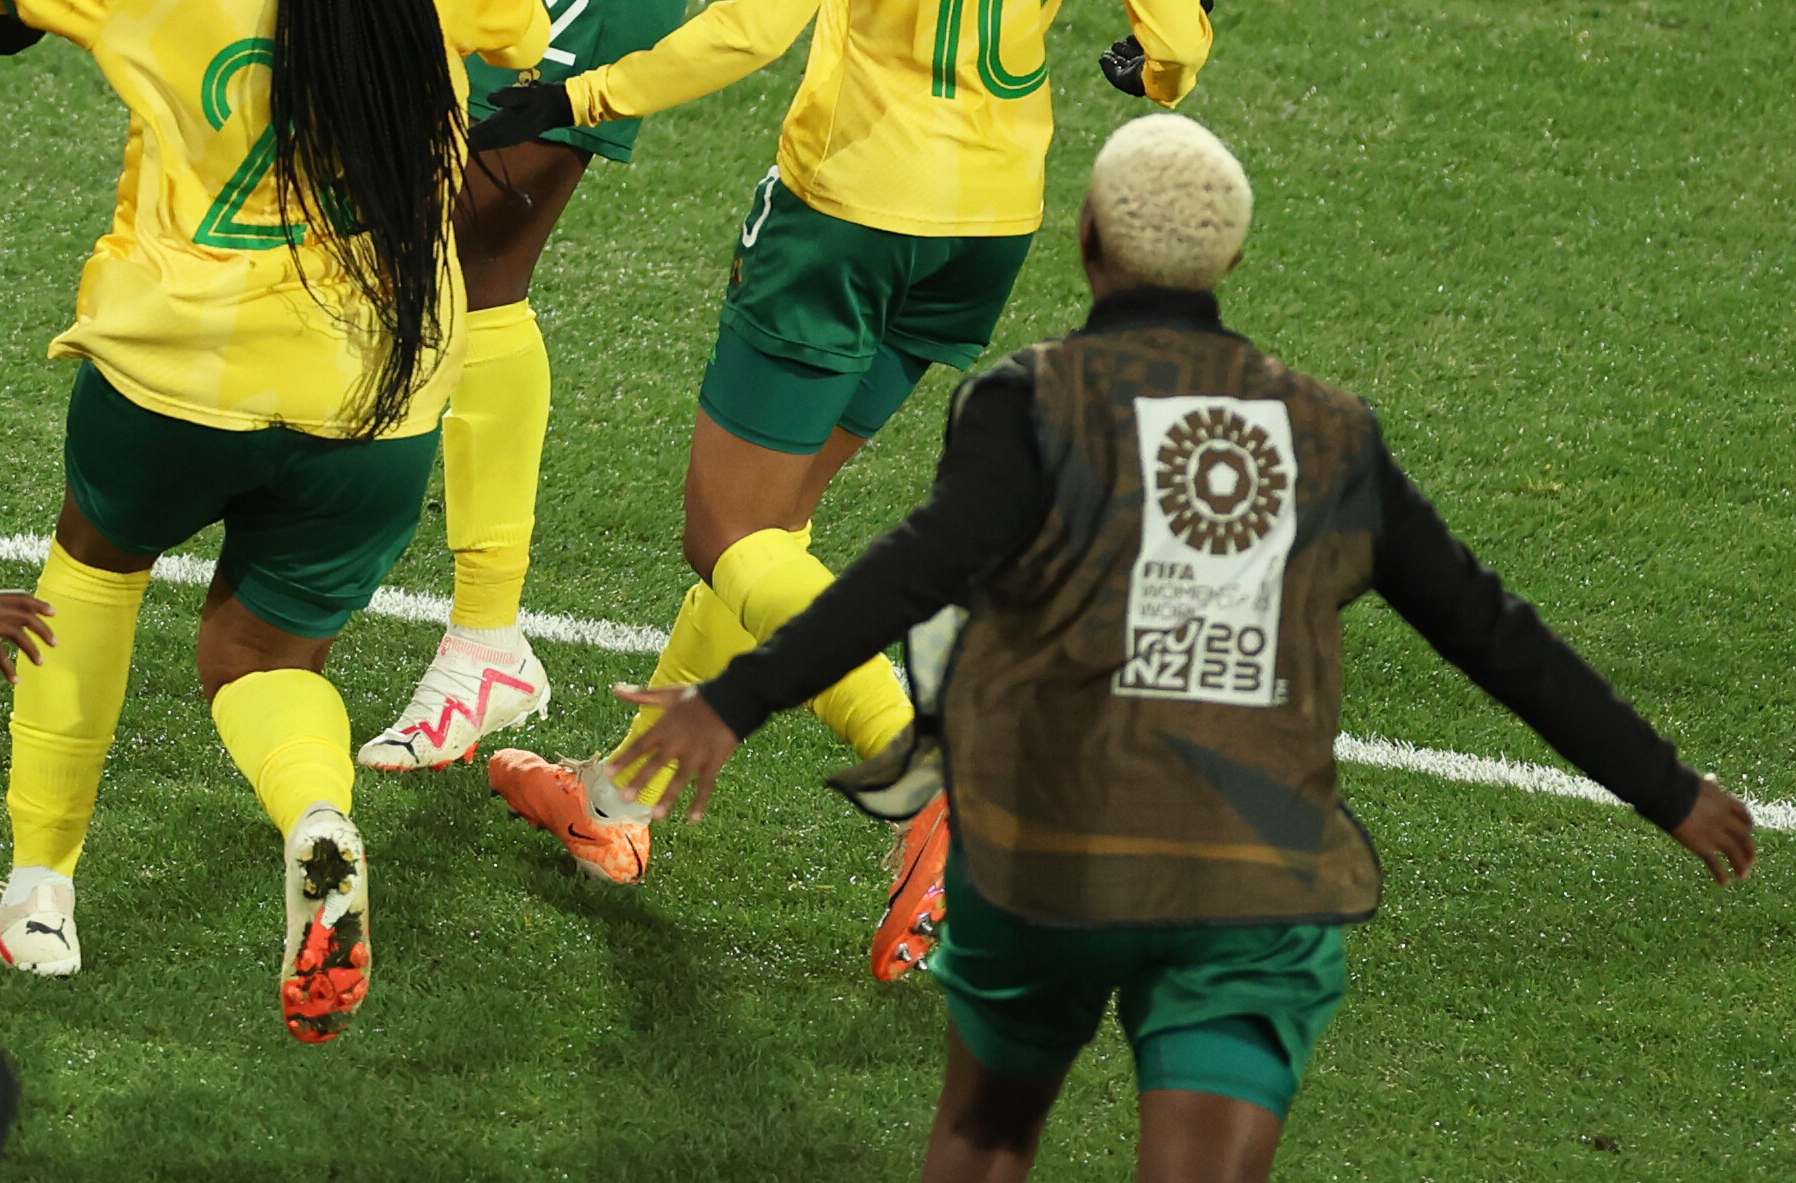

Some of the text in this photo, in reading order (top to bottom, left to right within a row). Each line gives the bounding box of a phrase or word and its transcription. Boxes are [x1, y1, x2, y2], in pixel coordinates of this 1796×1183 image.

[1207, 624, 1265, 656] 20
[1123, 653, 1189, 687] NZ
[1200, 659, 1261, 691] 23
